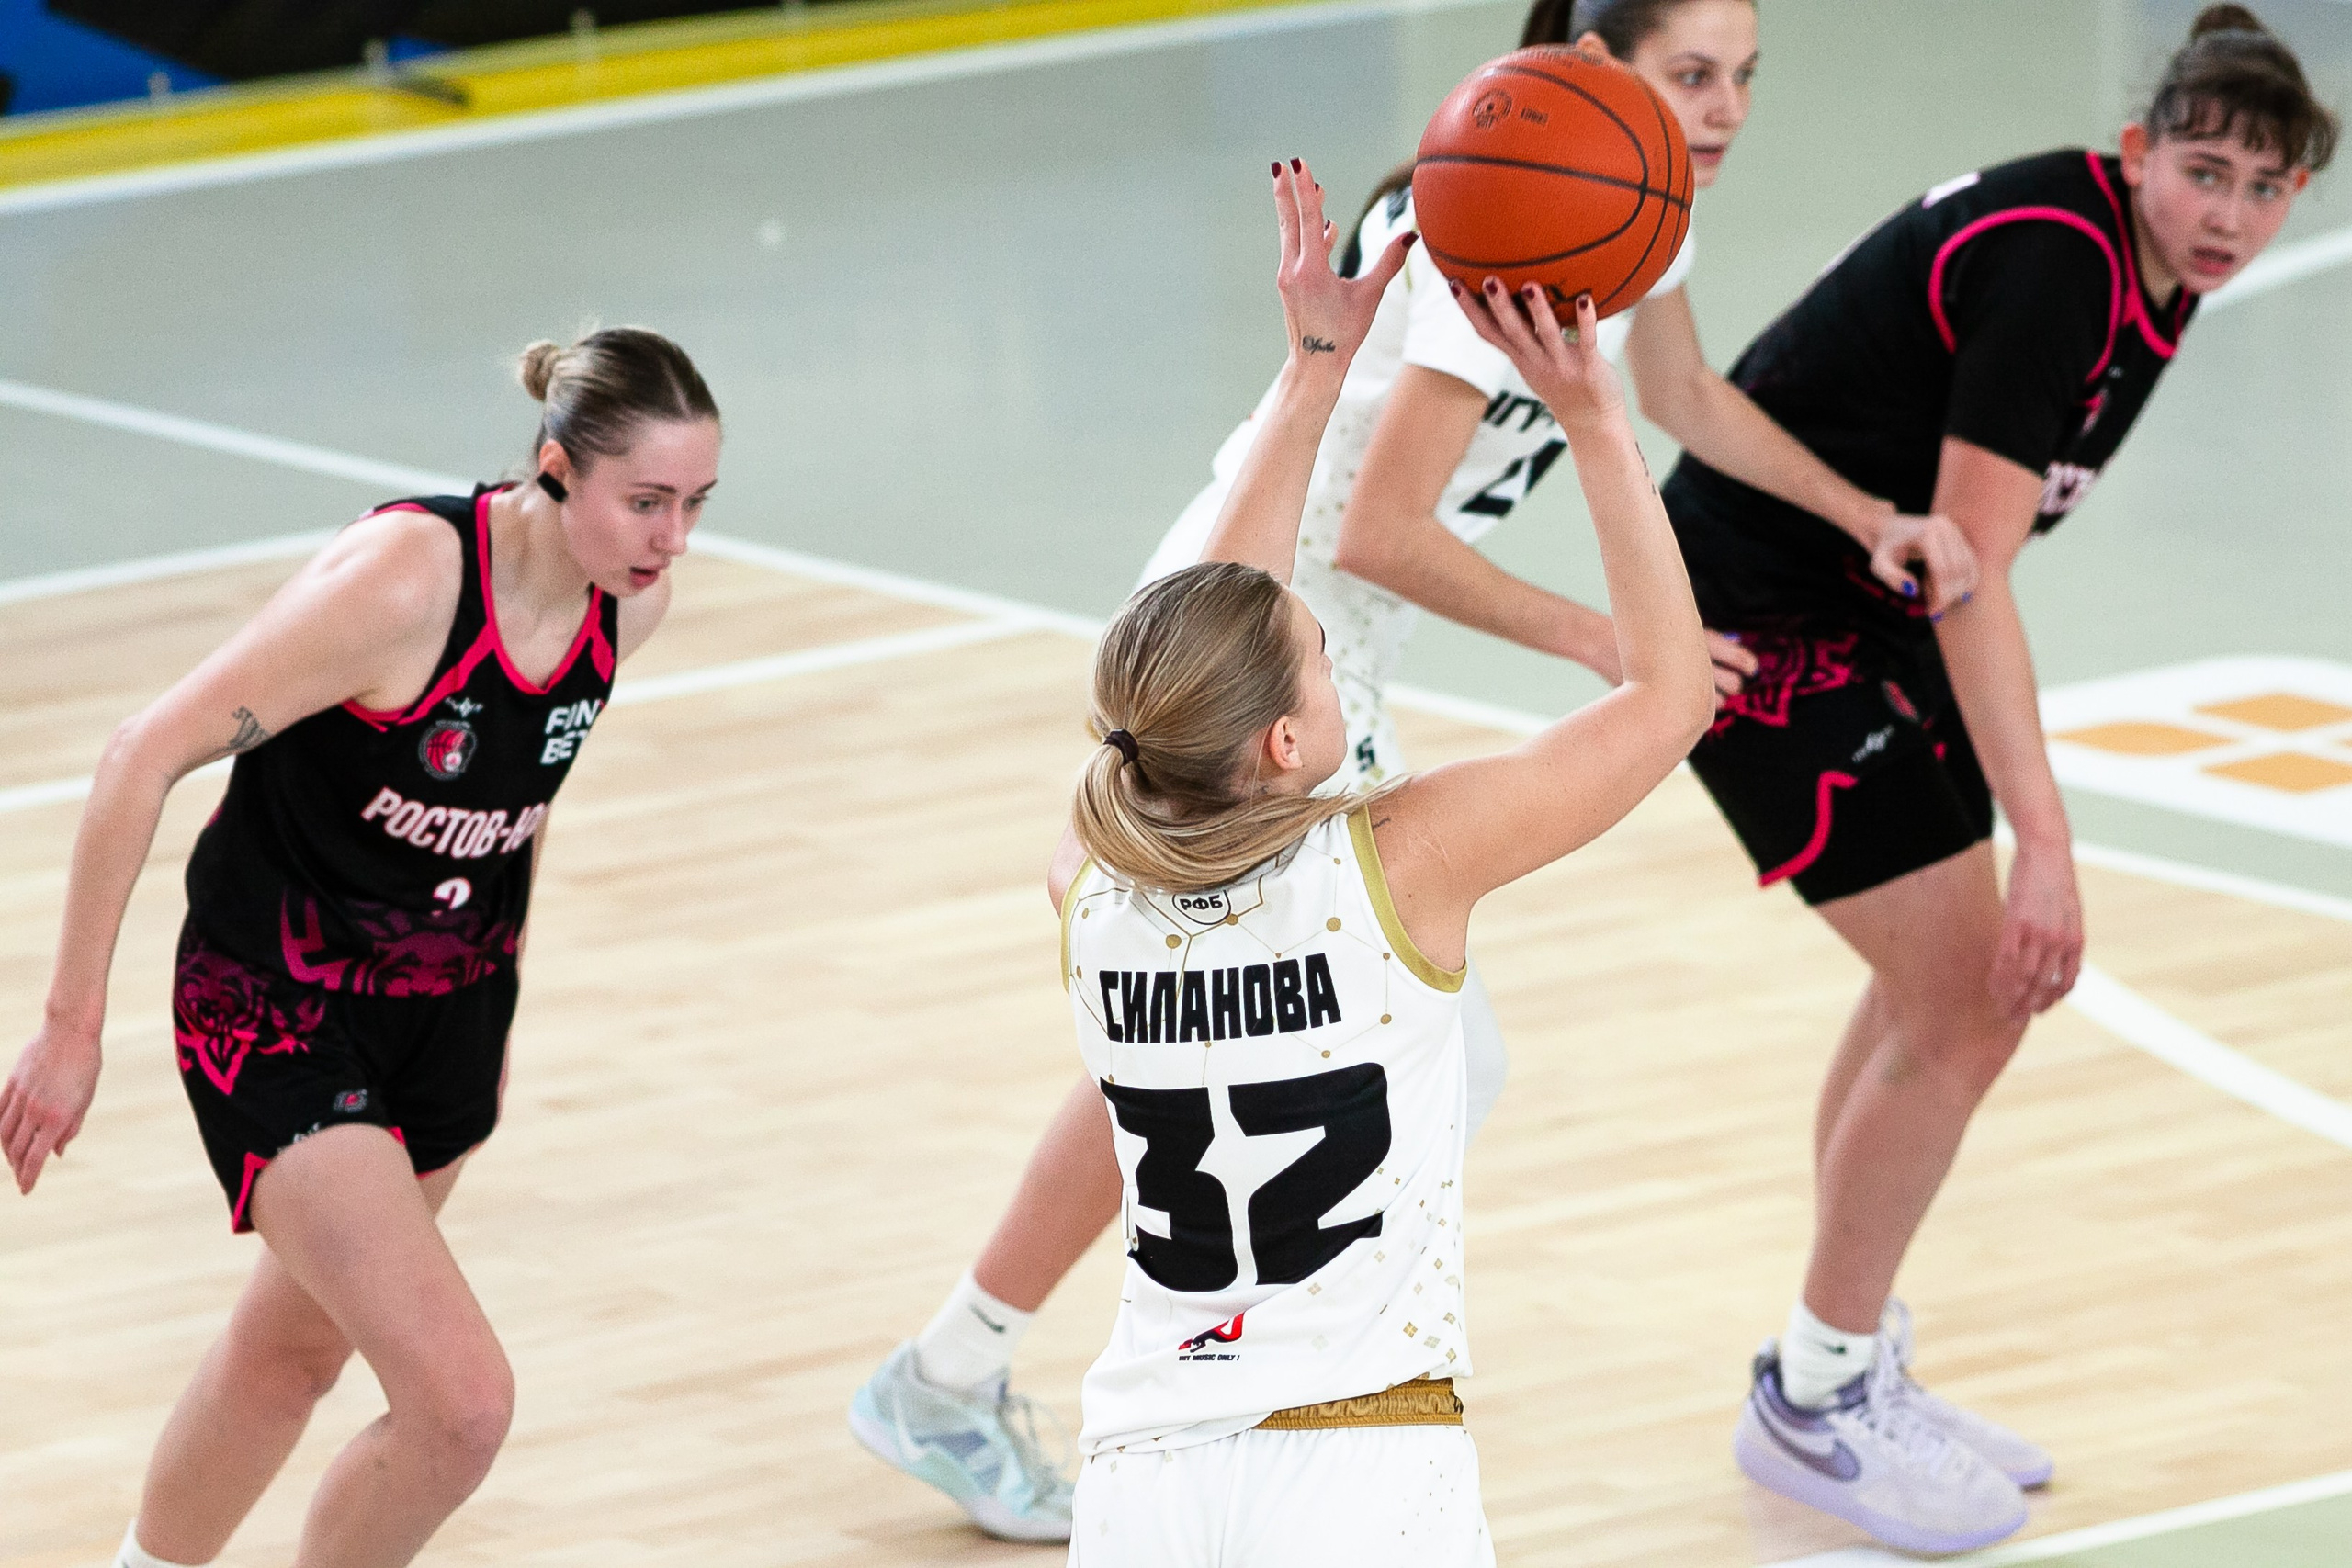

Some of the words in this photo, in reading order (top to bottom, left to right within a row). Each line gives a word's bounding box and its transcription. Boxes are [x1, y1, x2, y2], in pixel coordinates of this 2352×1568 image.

[545, 698, 602, 734] FIN
[361, 785, 550, 859] РОСТОВ-Н
[1180, 894, 1223, 910] РФБ
[1099, 953, 1341, 1043] СИЛАНОВА
[1100, 1062, 1392, 1292] 32
